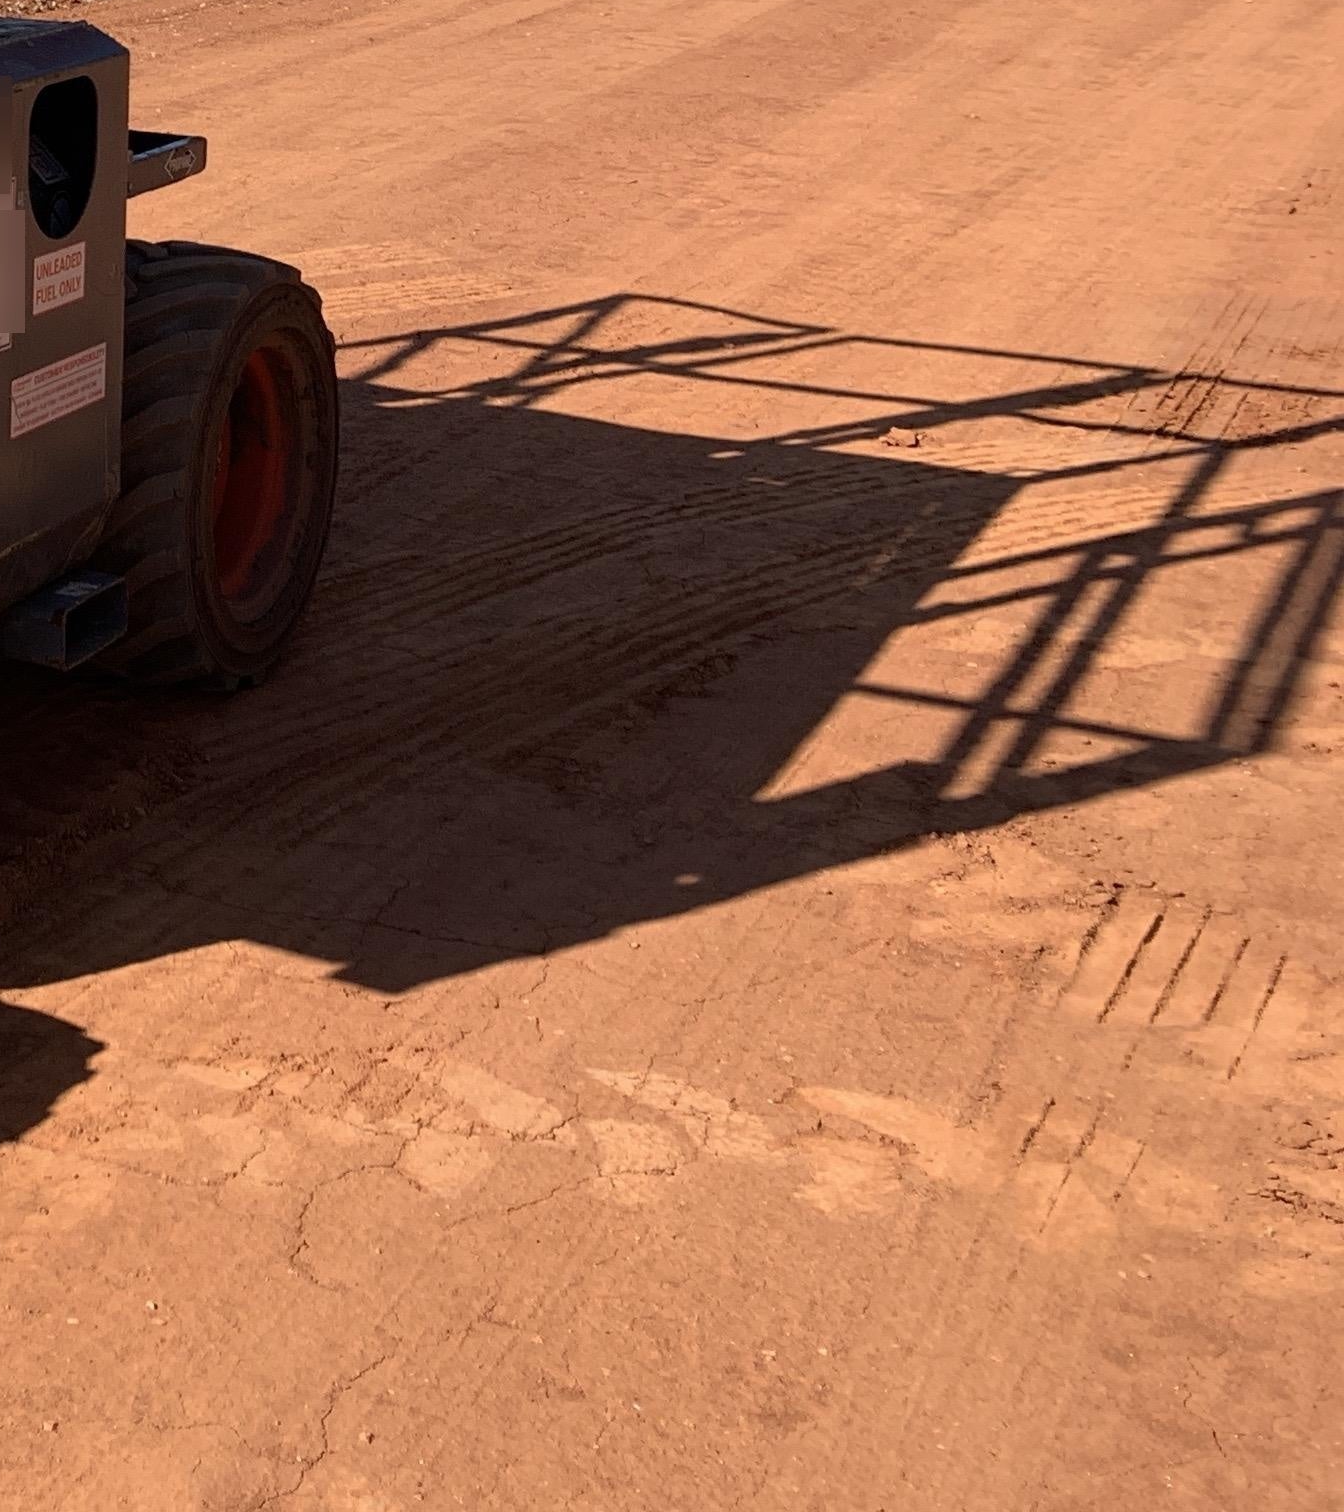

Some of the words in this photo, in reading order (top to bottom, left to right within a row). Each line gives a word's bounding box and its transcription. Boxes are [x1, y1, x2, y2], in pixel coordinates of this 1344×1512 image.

[36, 251, 81, 280] UNLEADED
[36, 285, 57, 305] FUEL
[59, 275, 81, 296] ONLY
